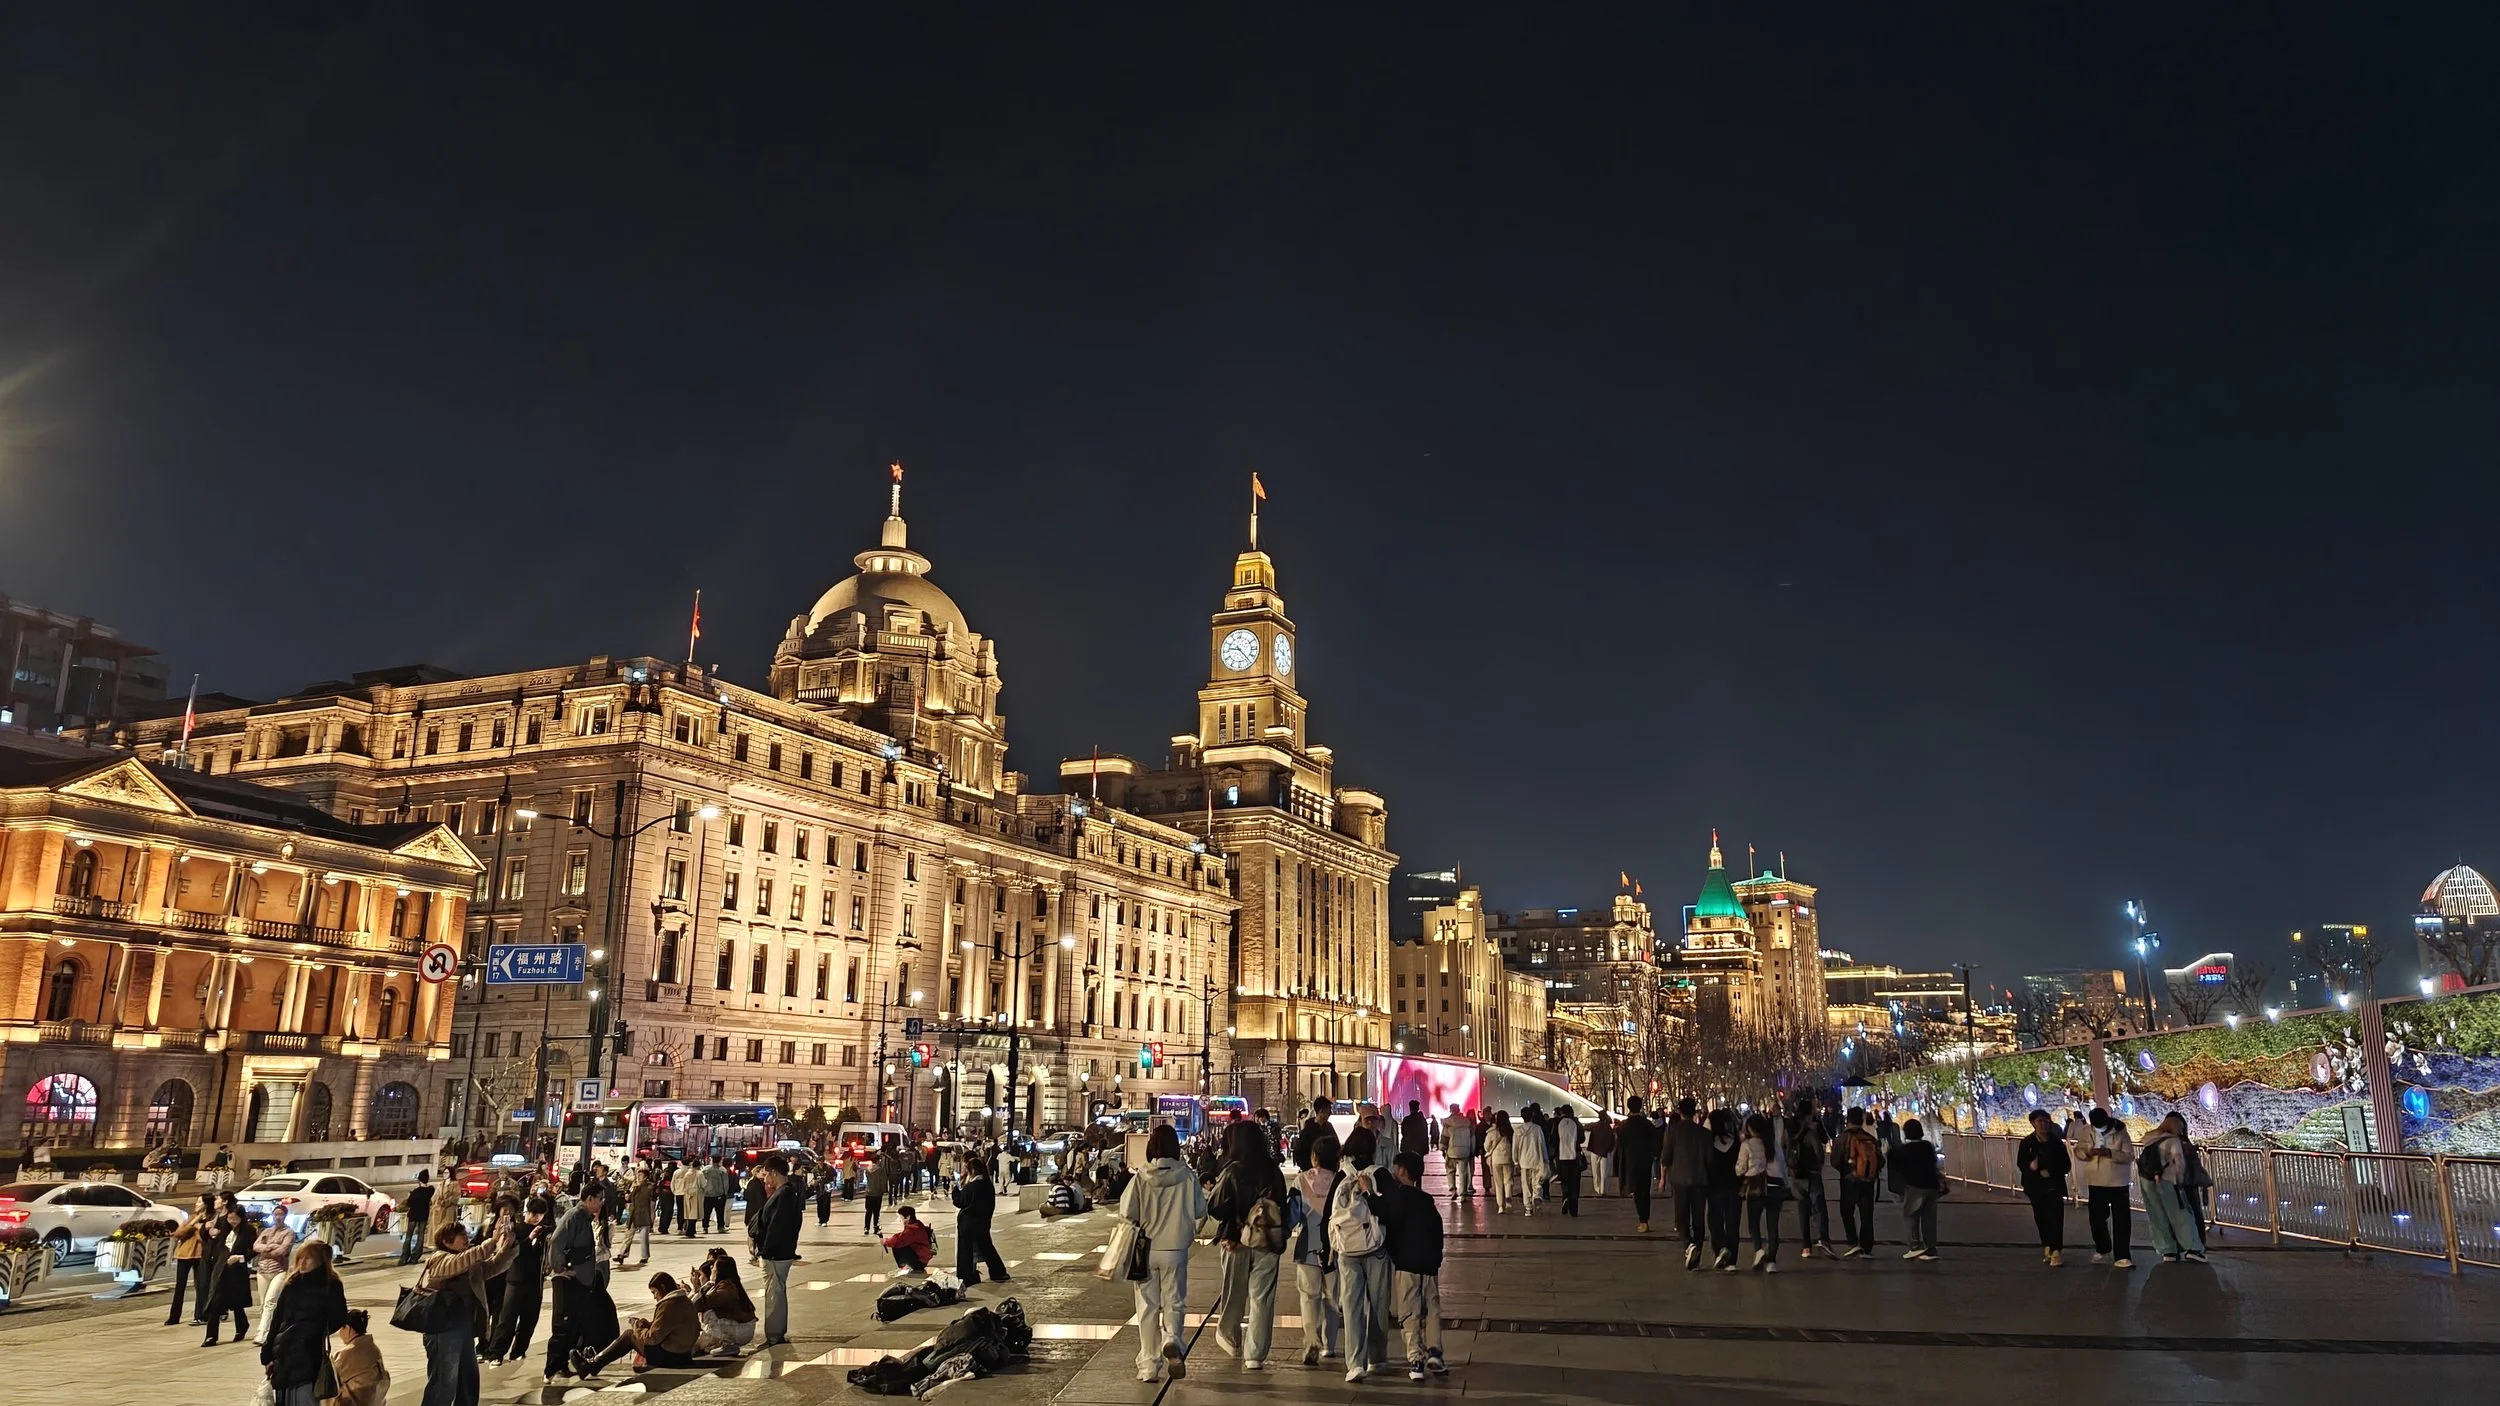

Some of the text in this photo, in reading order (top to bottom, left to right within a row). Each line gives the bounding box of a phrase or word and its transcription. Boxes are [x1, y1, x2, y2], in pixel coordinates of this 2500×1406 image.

[495, 949, 505, 957] 40
[492, 957, 500, 966] 西
[516, 951, 563, 966] 福州路
[574, 956, 582, 965] 东
[517, 966, 559, 975] Fuzhou Rd.
[492, 972, 500, 980] 17
